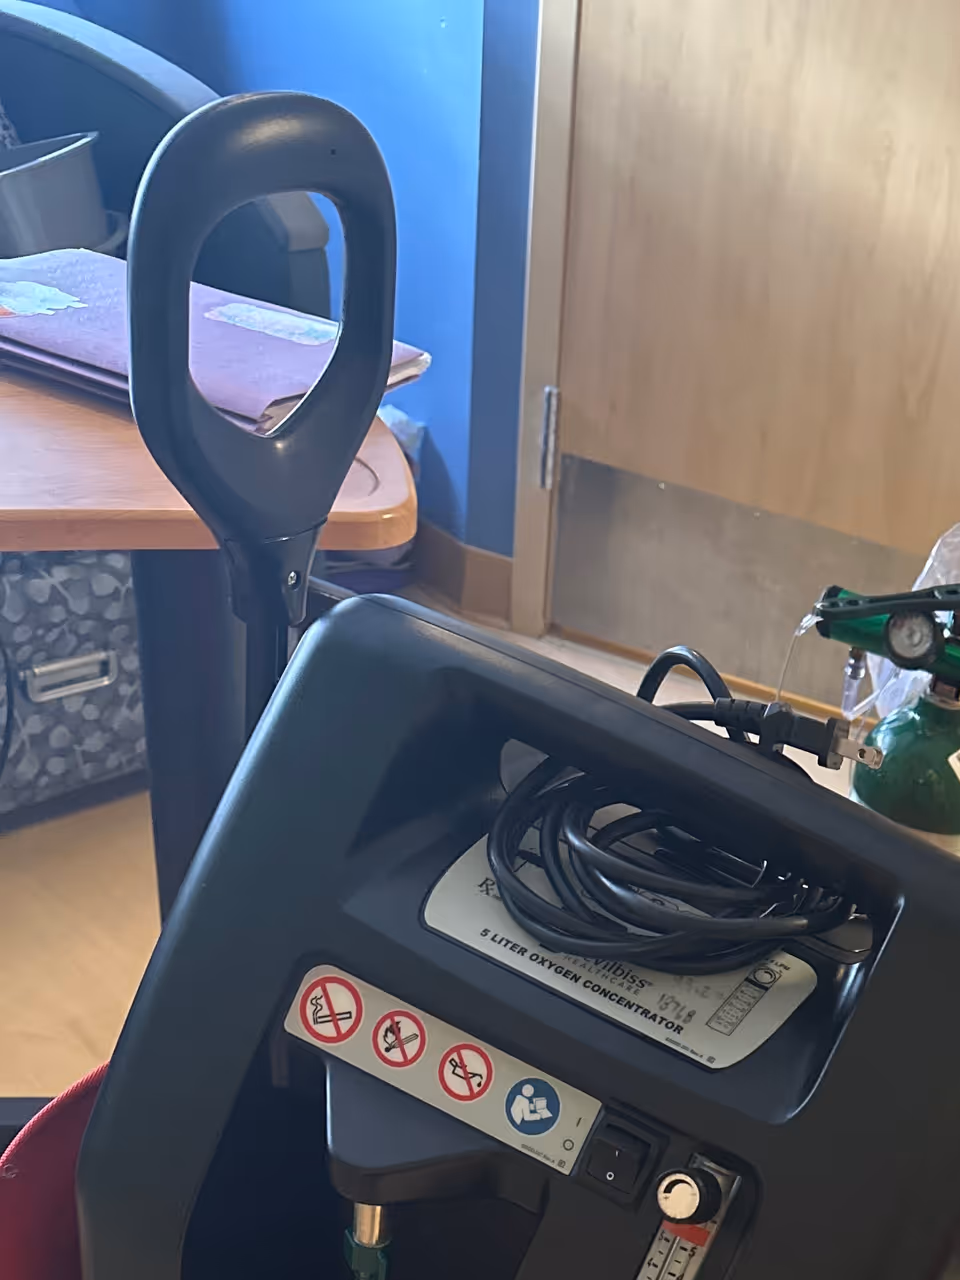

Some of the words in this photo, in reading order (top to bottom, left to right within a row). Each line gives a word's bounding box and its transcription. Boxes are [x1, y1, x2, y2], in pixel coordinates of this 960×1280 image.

[480, 928, 490, 937] 5
[490, 933, 528, 957] LITER
[529, 953, 582, 983] OXYGEN
[583, 979, 684, 1034] CONCENTRATOR
[688, 1246, 697, 1257] 5
